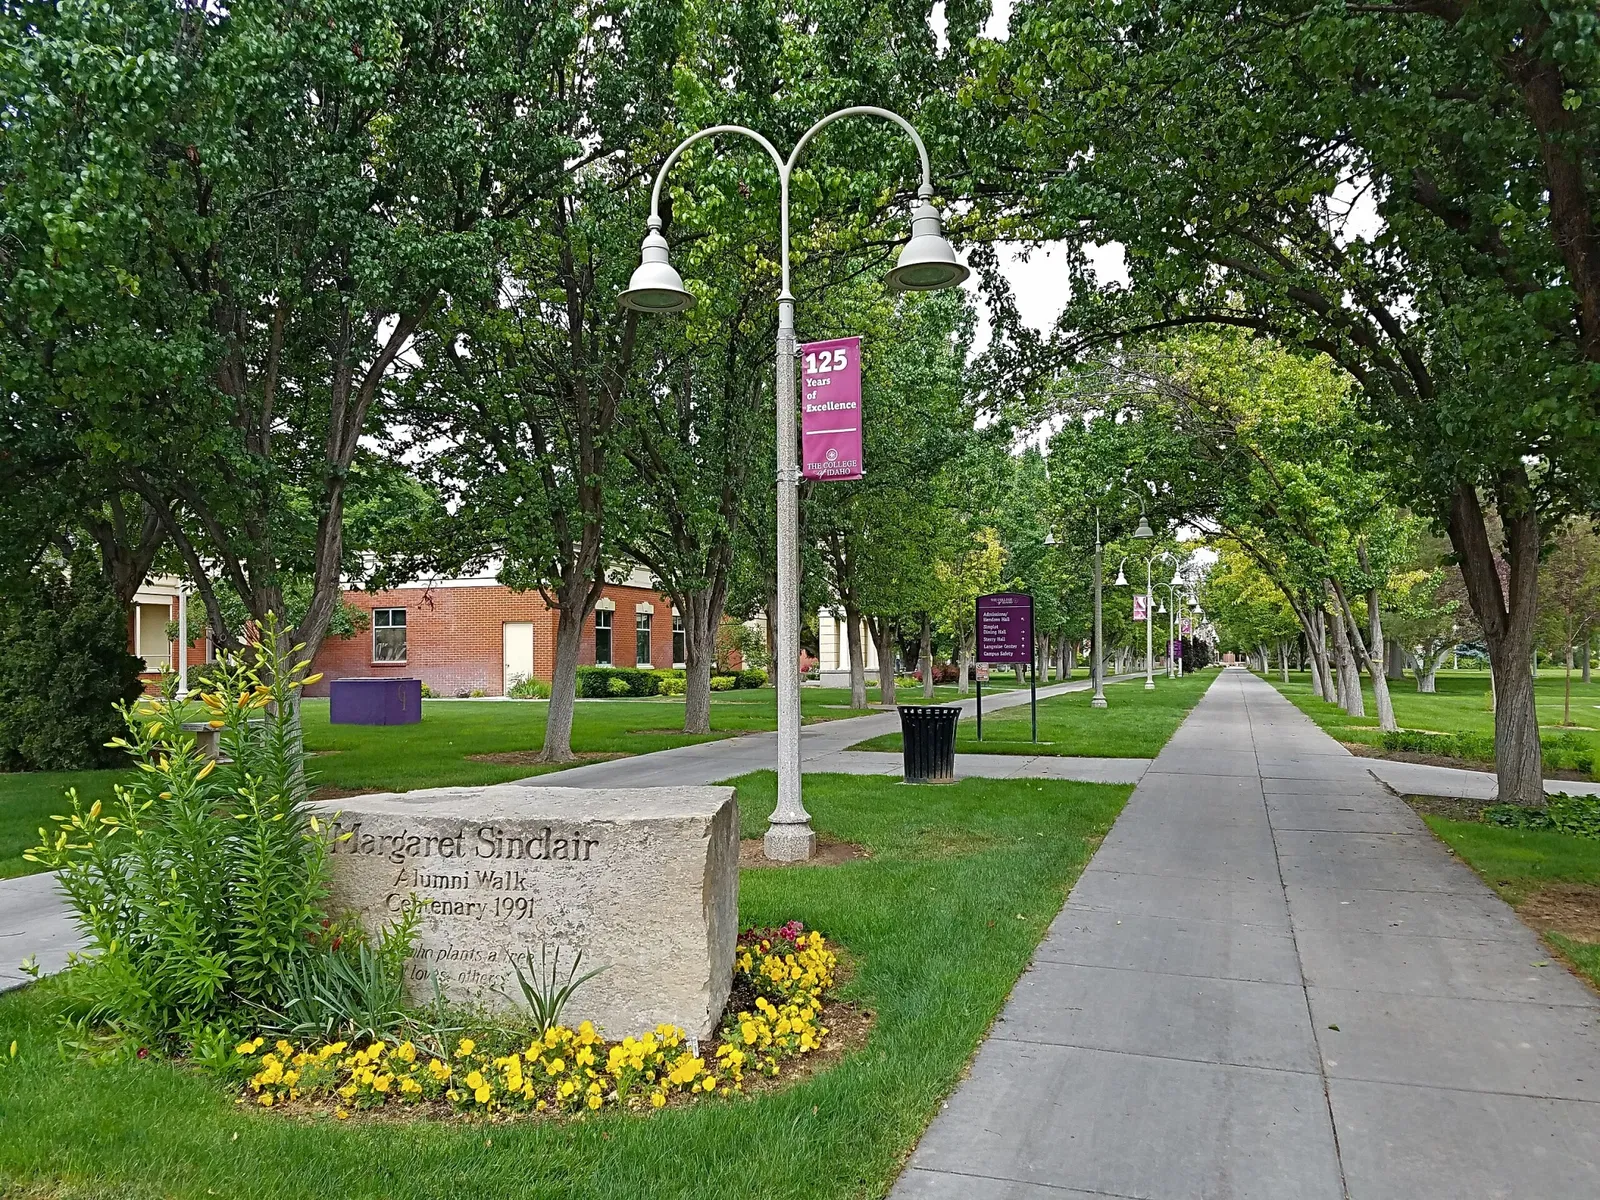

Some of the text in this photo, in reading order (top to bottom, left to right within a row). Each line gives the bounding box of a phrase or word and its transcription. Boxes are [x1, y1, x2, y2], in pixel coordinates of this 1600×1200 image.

[805, 349, 848, 374] 125
[806, 378, 831, 387] Years
[806, 390, 818, 400] of
[806, 401, 857, 413] Excellence
[823, 460, 857, 469] COLLEGE
[827, 468, 851, 476] IDAHO
[330, 822, 599, 864] Margaret Sinclair
[393, 867, 527, 891] Alumni Walk
[494, 896, 536, 921] 1991
[435, 943, 482, 963] plants
[487, 950, 498, 963] a
